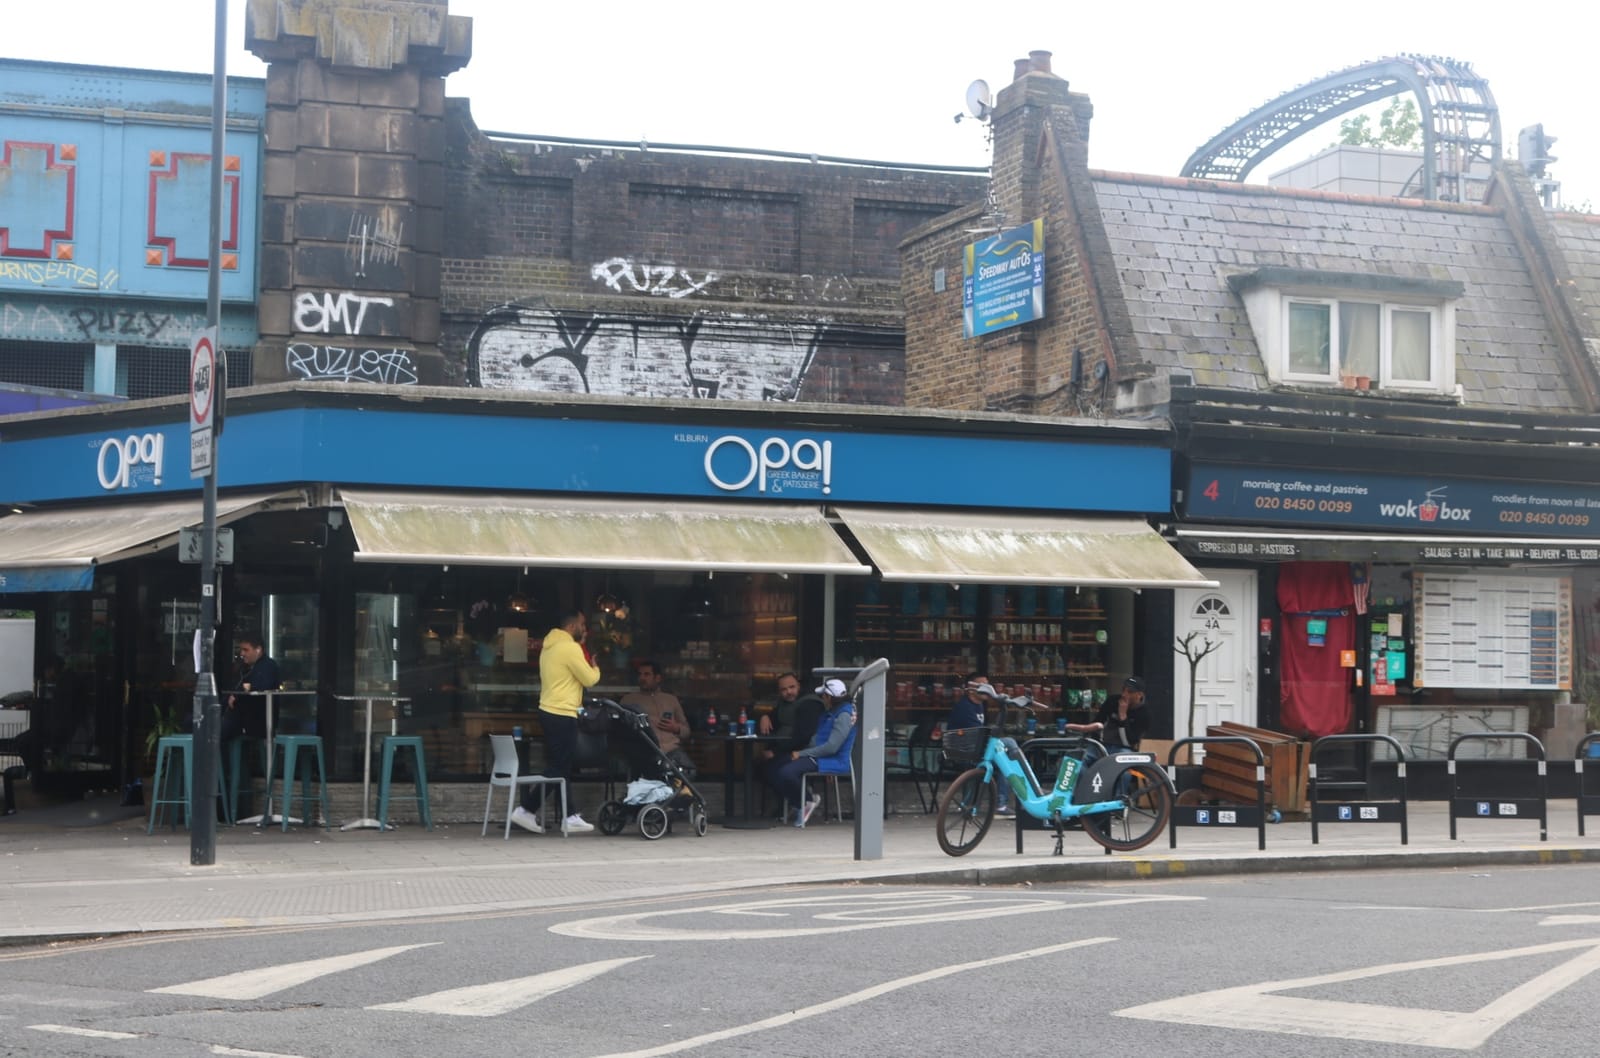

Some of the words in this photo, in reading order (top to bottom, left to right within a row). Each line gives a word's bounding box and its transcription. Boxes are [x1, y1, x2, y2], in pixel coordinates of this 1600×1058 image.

[674, 433, 709, 443] KILBURN
[767, 471, 790, 479] GREEK
[791, 472, 820, 480] BAKERY
[1203, 480, 1219, 501] 4
[1243, 480, 1281, 492] morning
[1283, 482, 1311, 492] coffee
[1314, 485, 1330, 493] and
[1332, 486, 1368, 495] pastries
[1255, 497, 1280, 509] 020
[1282, 498, 1315, 511] 8450
[1318, 500, 1352, 513] 0099
[1492, 494, 1527, 504] noodles
[1528, 496, 1549, 505] from
[1550, 498, 1573, 506] noon
[1380, 500, 1418, 519] wok
[1440, 502, 1472, 521] box
[1500, 511, 1522, 523] 020
[1525, 512, 1556, 524] 8450
[1558, 514, 1590, 526] 0099
[1238, 544, 1254, 554] BAR
[1260, 544, 1295, 555] PASTRIES
[1060, 761, 1076, 790] forest
